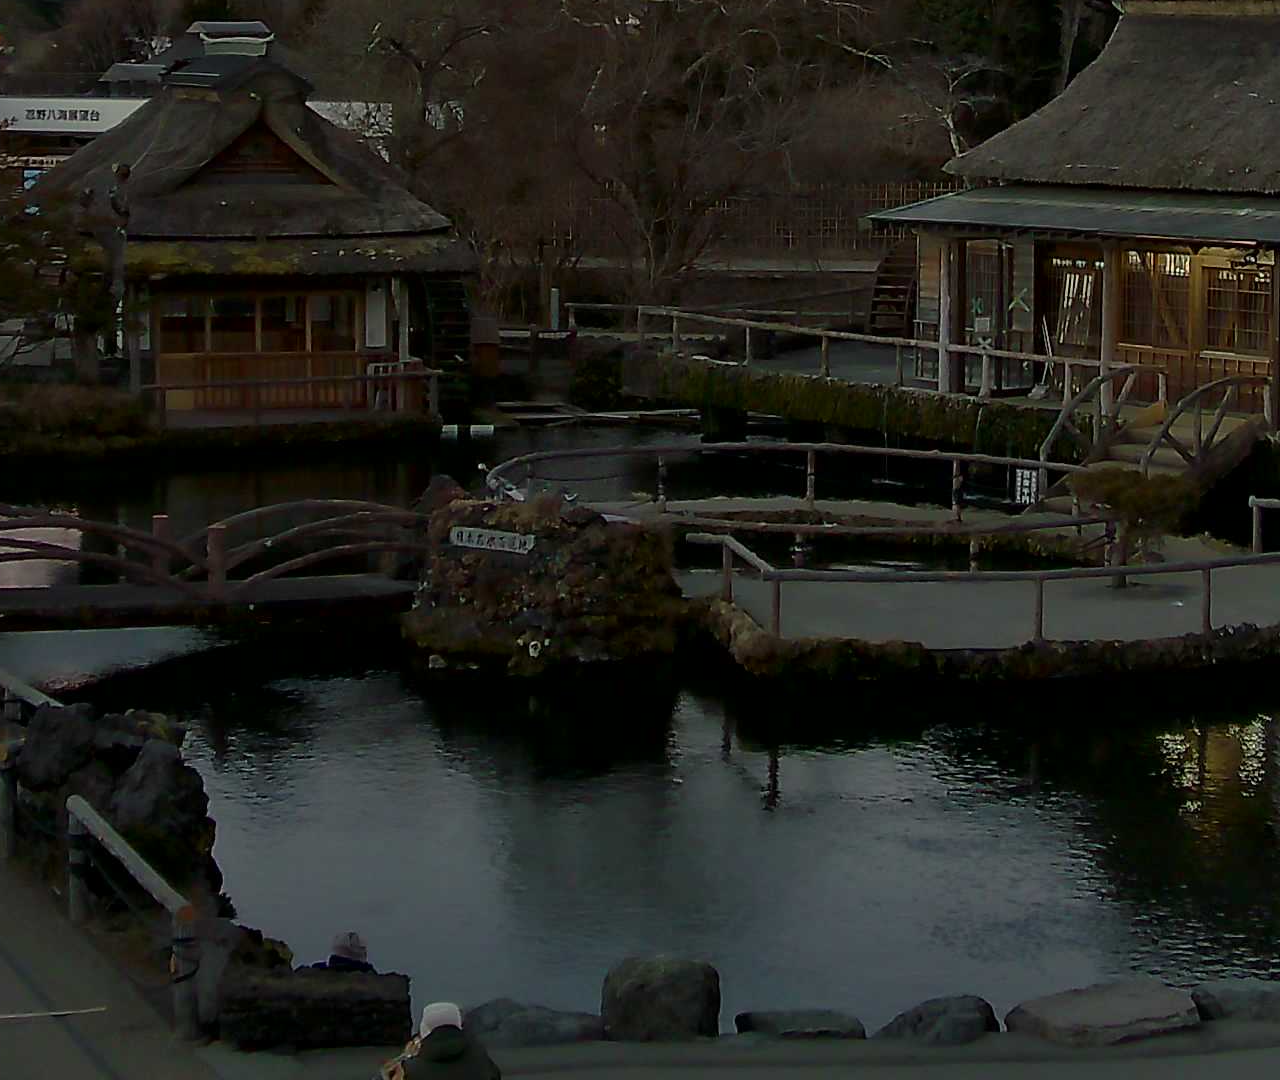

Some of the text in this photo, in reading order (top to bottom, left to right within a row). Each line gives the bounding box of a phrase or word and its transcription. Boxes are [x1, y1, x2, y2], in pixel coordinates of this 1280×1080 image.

[24, 109, 101, 122] 忍野八海展望台
